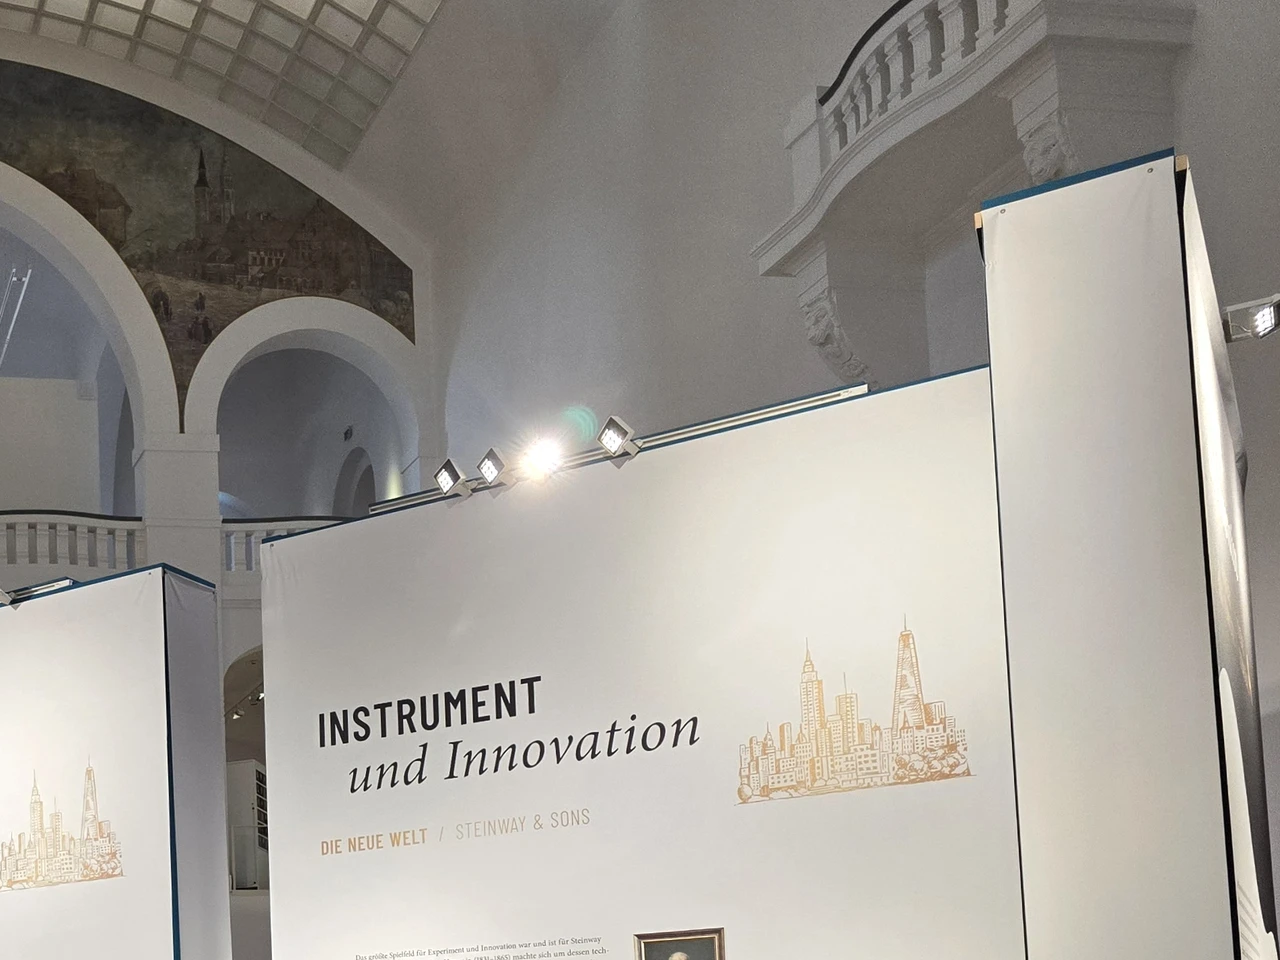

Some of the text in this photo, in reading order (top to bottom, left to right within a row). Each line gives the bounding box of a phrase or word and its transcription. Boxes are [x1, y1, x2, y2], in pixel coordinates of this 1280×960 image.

[319, 676, 541, 747] INSTRUMENT
[348, 714, 700, 793] und Innovation
[321, 839, 342, 855] DIE
[348, 834, 384, 853] NEUE
[389, 828, 428, 847] WELT
[456, 816, 526, 840] STEINWAY
[533, 814, 544, 830] &
[550, 808, 590, 828] SONS
[390, 949, 415, 960] Spielfeld
[428, 946, 465, 958] Experiment
[466, 944, 480, 953] und
[481, 942, 517, 952] Innovation
[533, 939, 547, 948] und
[558, 937, 569, 946] für
[571, 935, 601, 947] Steinway
[513, 951, 537, 960] machte
[538, 950, 552, 959] sich
[567, 947, 590, 957] dessen
[592, 946, 610, 955] tech-
